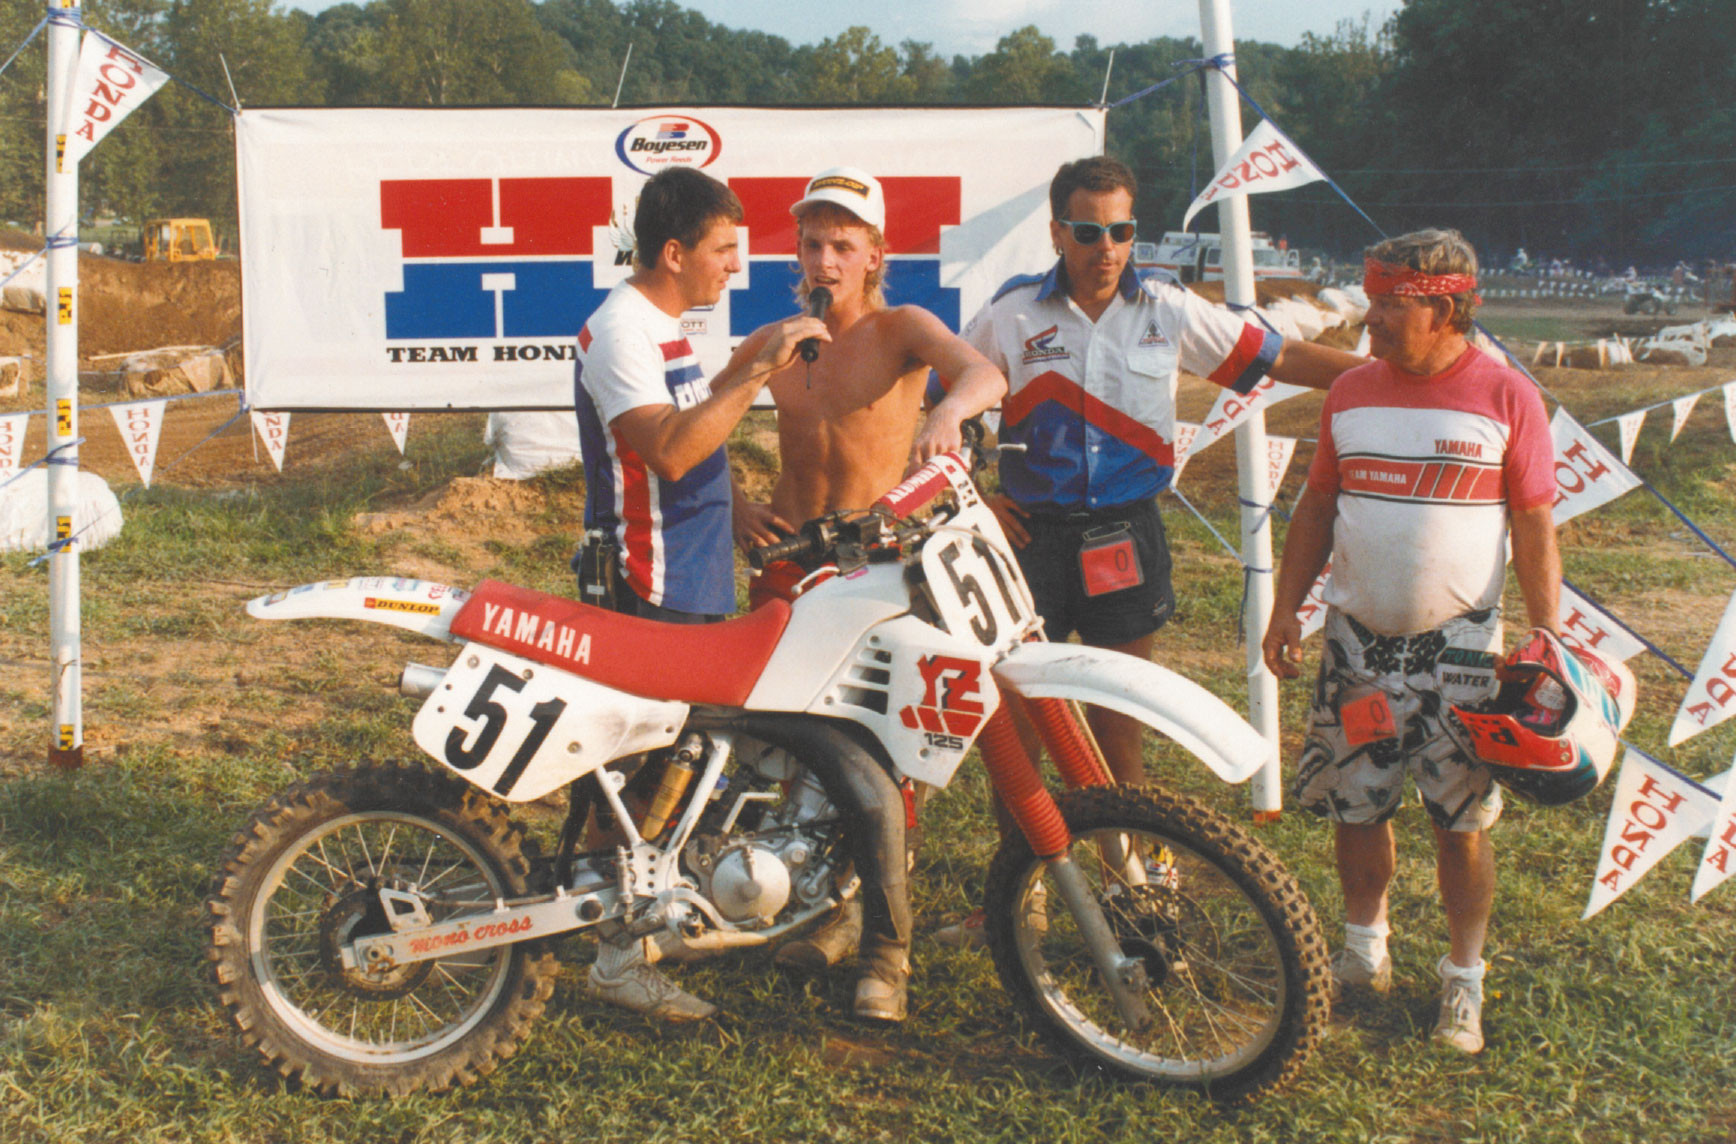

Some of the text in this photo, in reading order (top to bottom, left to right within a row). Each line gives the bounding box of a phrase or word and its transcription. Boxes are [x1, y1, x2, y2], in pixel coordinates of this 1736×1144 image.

[76, 46, 143, 142] HONDA
[630, 137, 708, 154] Boyesen
[386, 345, 576, 362] TEAM HON
[1024, 347, 1064, 358] HONDA
[1434, 440, 1482, 457] YAMAHA
[1268, 441, 1283, 489] HONDA
[1370, 470, 1406, 484] YAMAHA
[938, 524, 1022, 646] 51
[376, 600, 439, 614] DUNLOP
[481, 602, 592, 666] YAMAHA
[1445, 650, 1494, 667] TONIC
[917, 653, 984, 714] YZ
[1442, 671, 1490, 687] WATER
[445, 663, 567, 797] 51
[924, 732, 963, 750] 125
